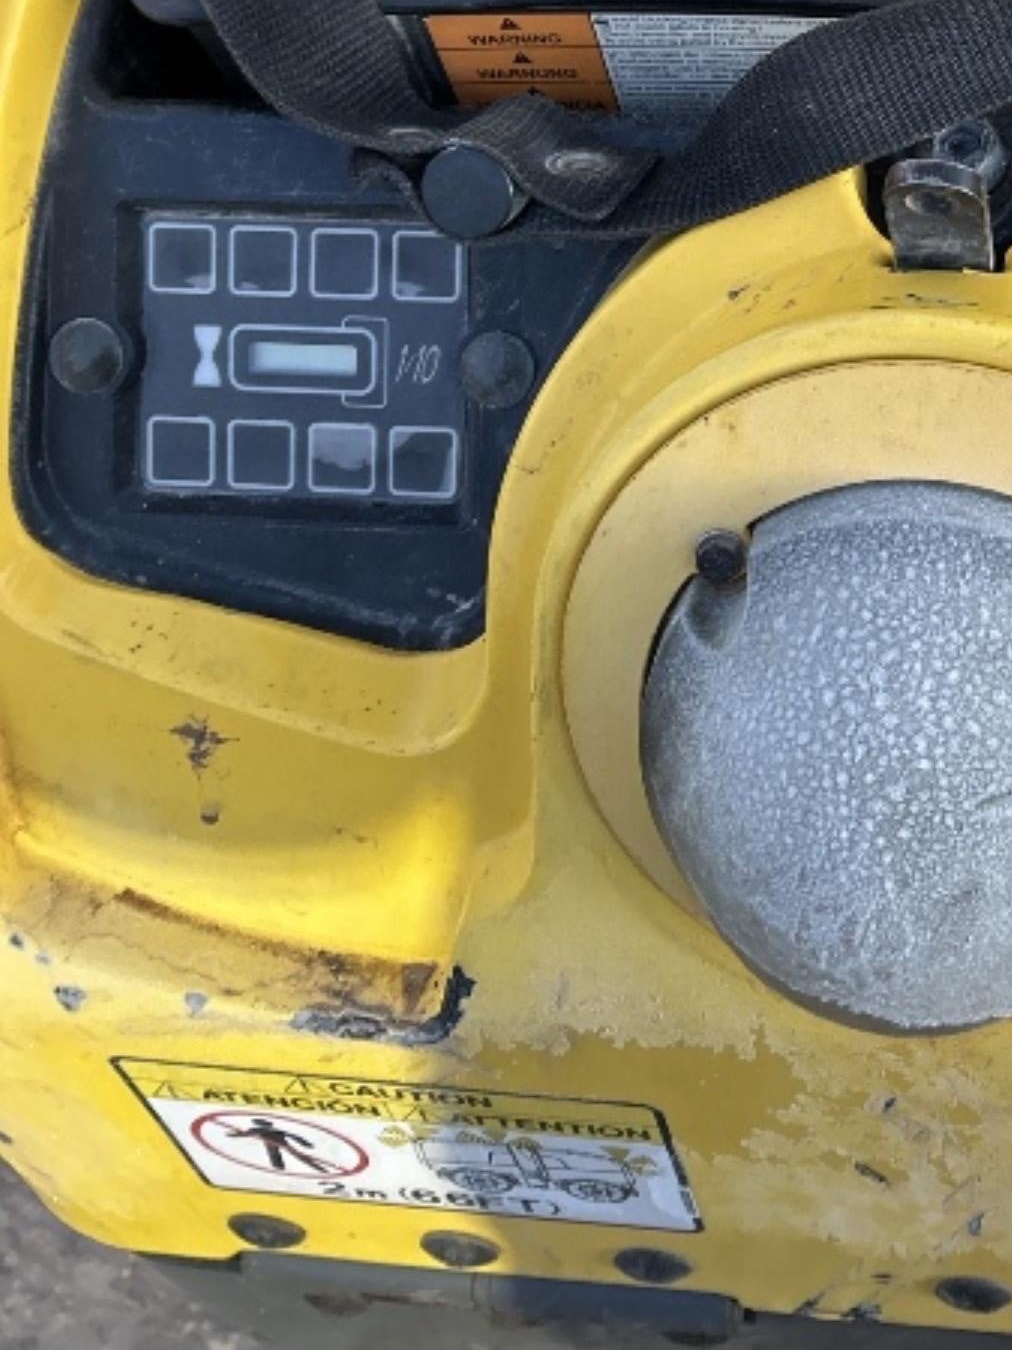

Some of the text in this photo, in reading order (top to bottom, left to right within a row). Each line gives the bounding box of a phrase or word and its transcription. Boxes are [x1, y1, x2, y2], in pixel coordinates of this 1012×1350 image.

[329, 1082, 494, 1108] CAUTION
[451, 1113, 652, 1140] ATTENTION
[317, 1181, 346, 1196] 2
[354, 1187, 388, 1199] m
